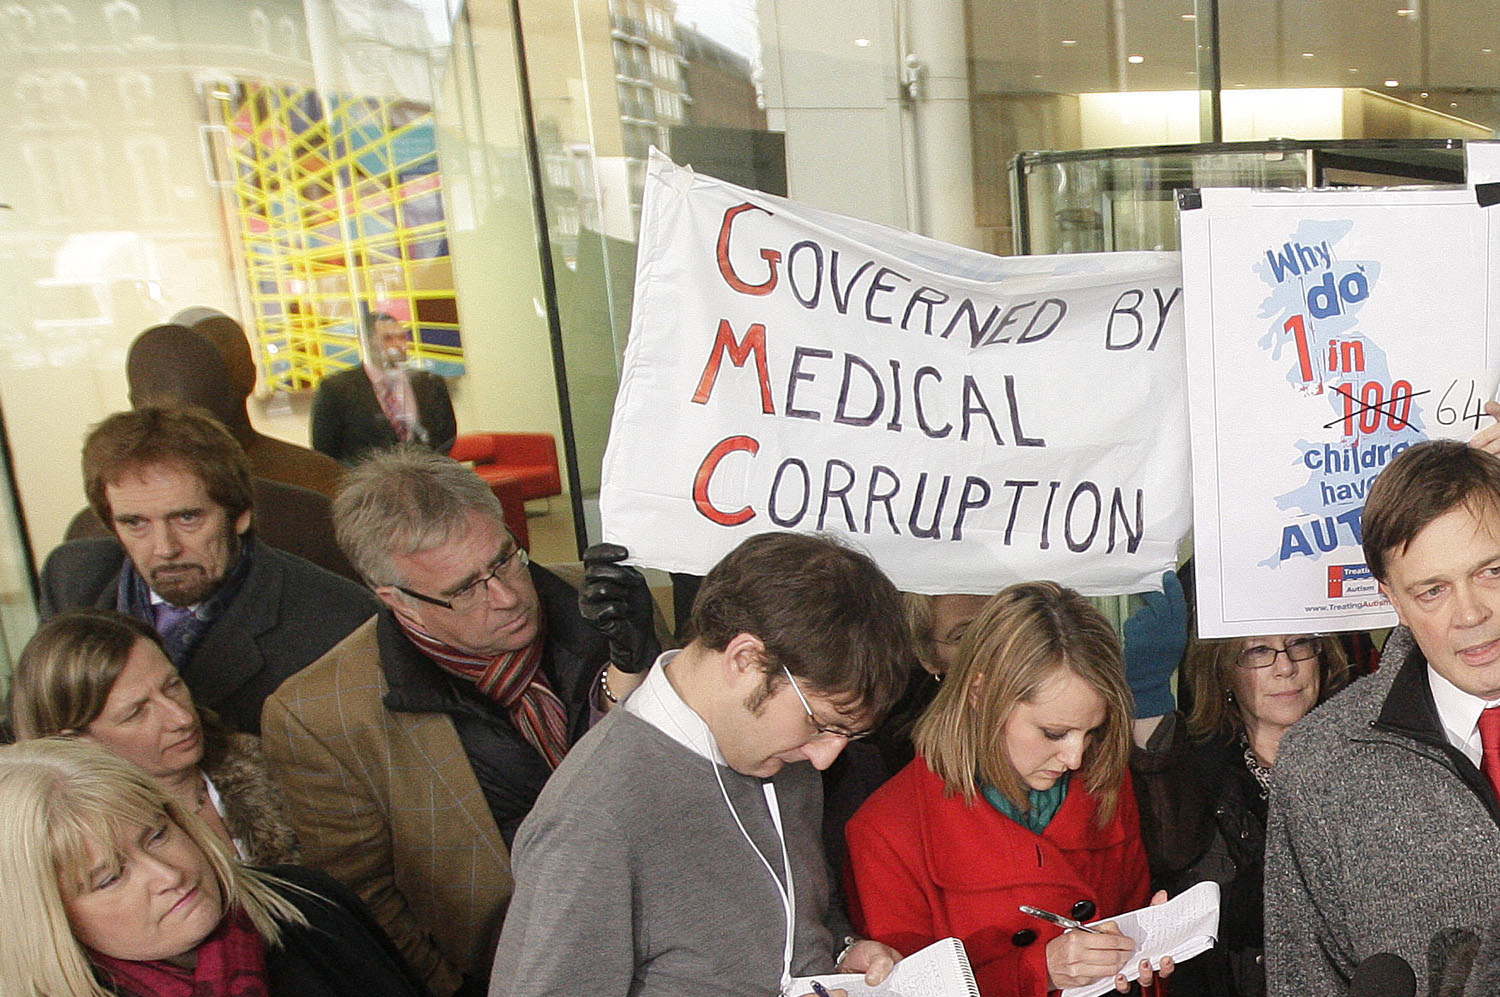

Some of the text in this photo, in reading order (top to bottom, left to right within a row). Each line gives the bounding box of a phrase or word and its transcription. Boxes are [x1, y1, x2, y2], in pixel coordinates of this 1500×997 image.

[716, 202, 1182, 351] GOVERNED BY
[1267, 240, 1331, 283] Why
[1306, 271, 1369, 319] do
[1284, 314, 1366, 382] 1 in
[691, 318, 1046, 448] MEDICAL
[1336, 380, 1413, 436] 100
[1436, 379, 1493, 430] 64
[692, 435, 1144, 554] CORRUPTION
